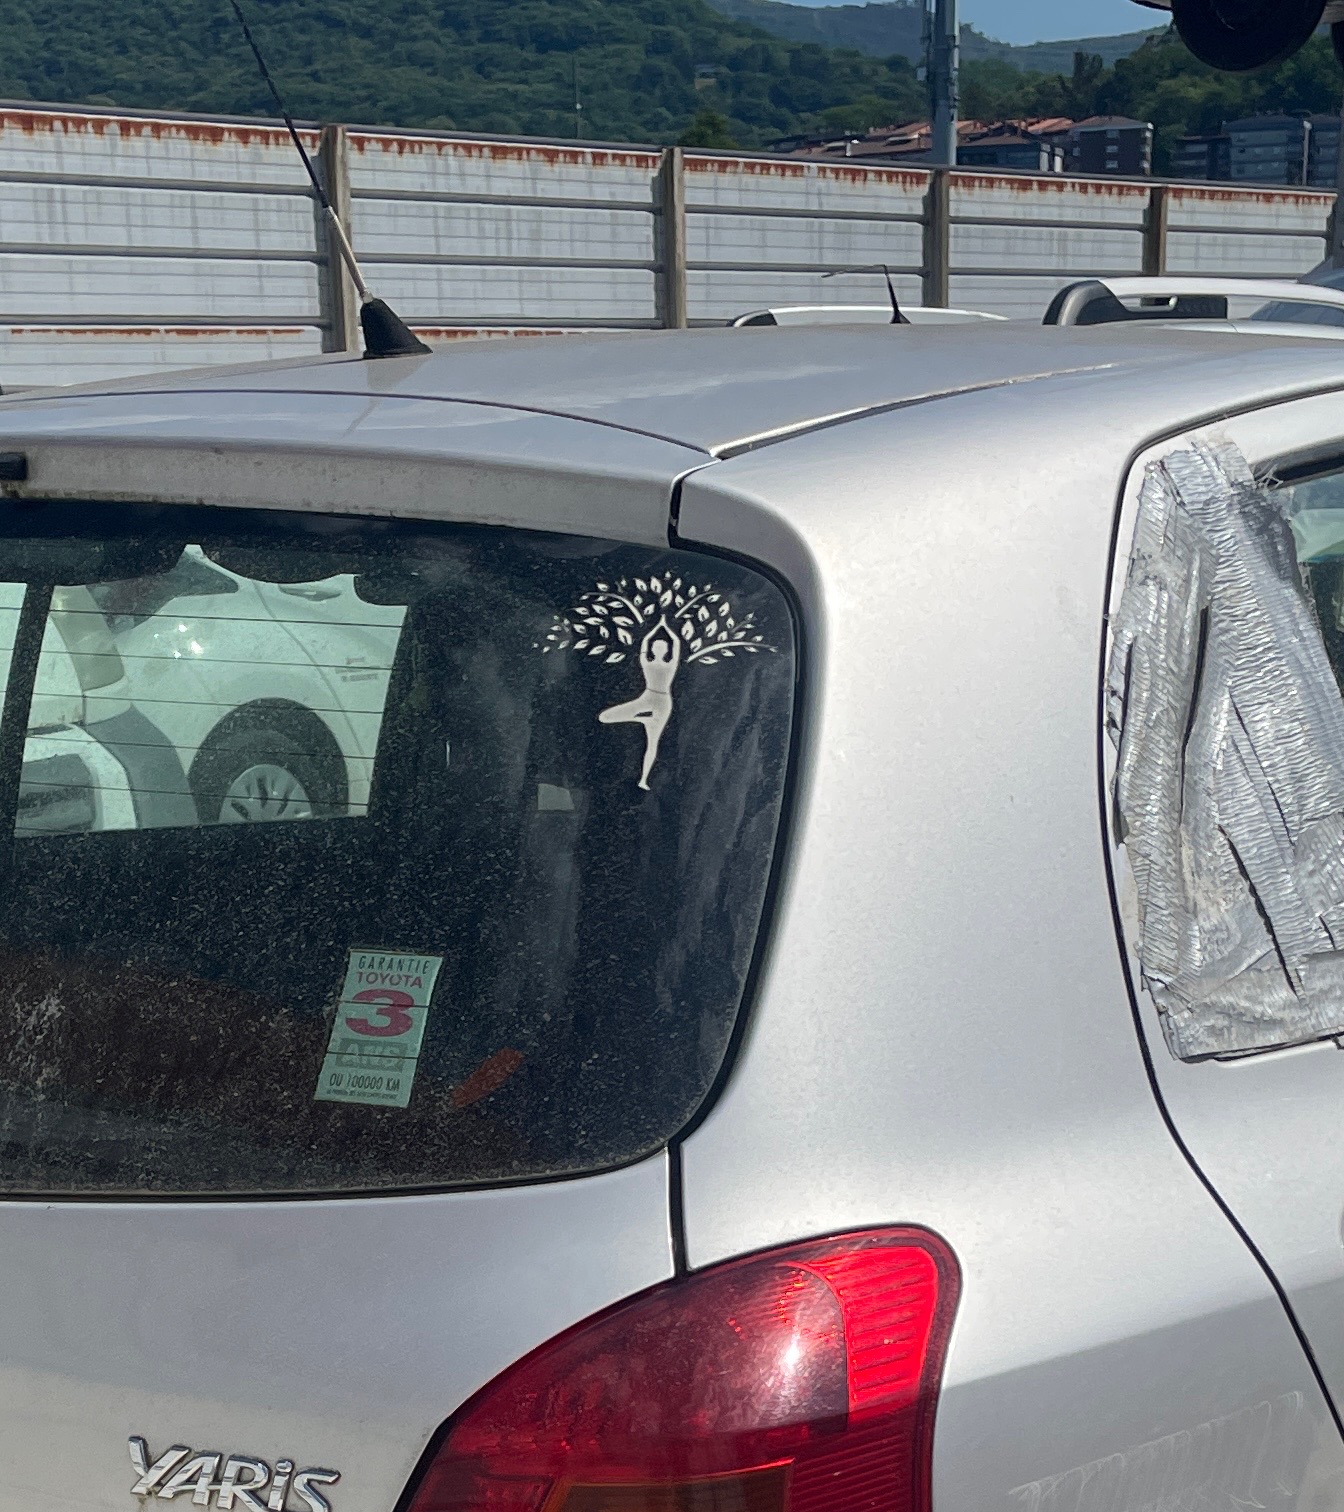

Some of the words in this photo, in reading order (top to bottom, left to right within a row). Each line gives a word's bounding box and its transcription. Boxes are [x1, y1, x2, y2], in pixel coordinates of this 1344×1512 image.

[358, 955, 430, 975] GARANTIE
[356, 971, 423, 989] TOYOTA
[345, 987, 415, 1037] 3
[329, 1072, 344, 1087] OU
[385, 1077, 400, 1092] KM
